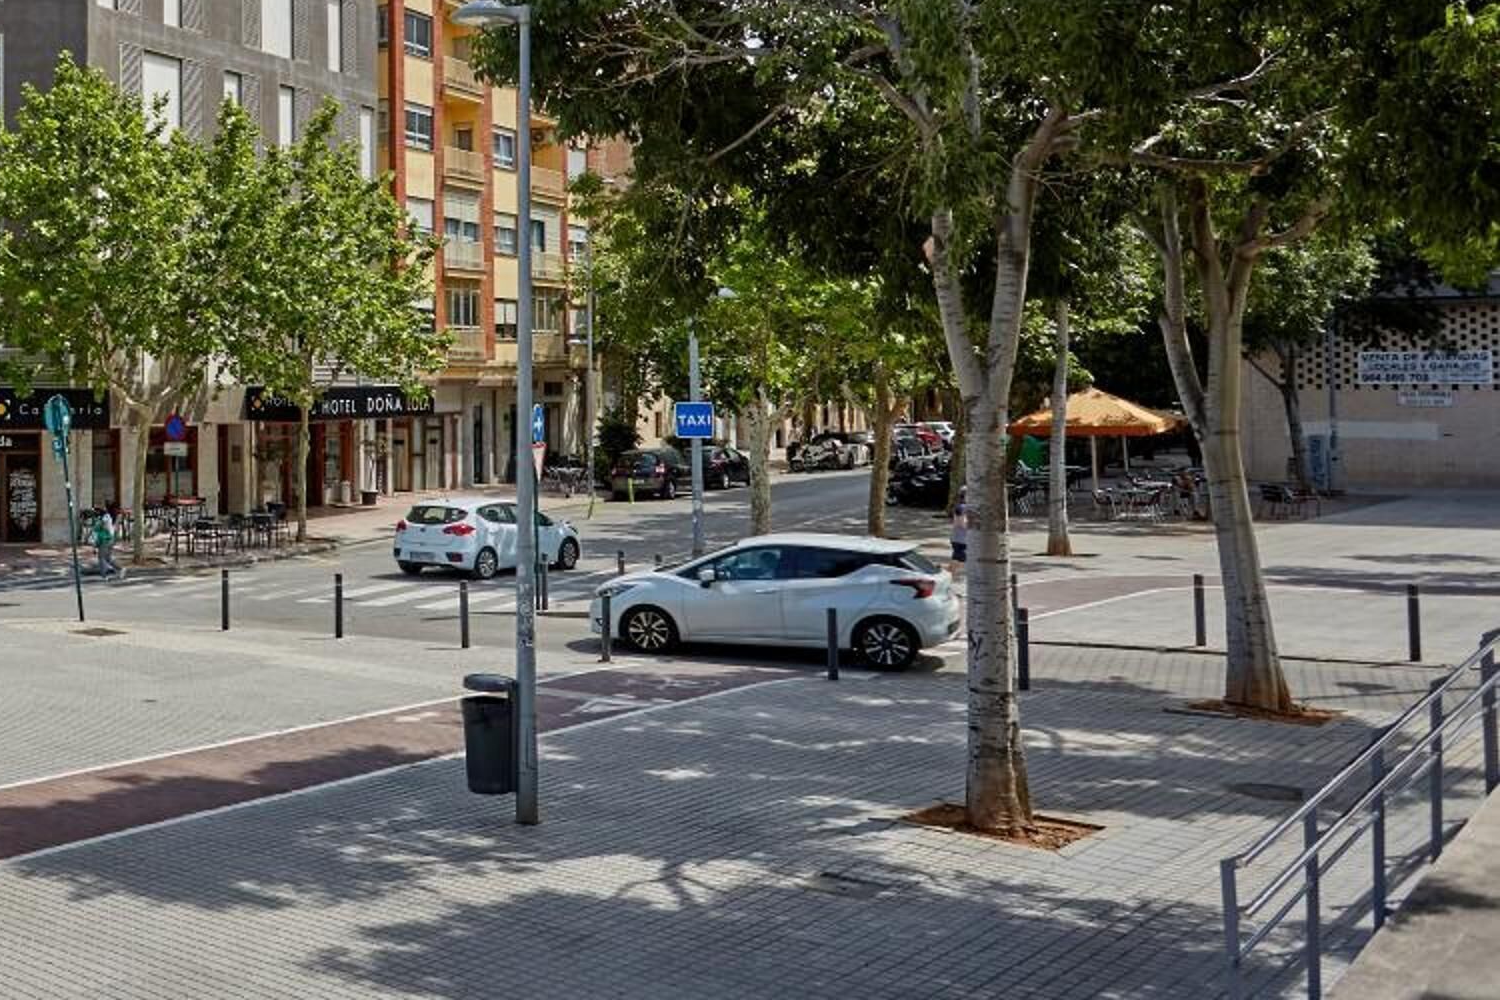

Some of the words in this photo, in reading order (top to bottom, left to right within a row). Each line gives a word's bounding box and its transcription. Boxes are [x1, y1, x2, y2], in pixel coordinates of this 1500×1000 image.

[1361, 353, 1399, 361] VENTA
[321, 399, 357, 414] HOTEL
[366, 393, 403, 413] DOÑA
[678, 415, 711, 425] TAXI
